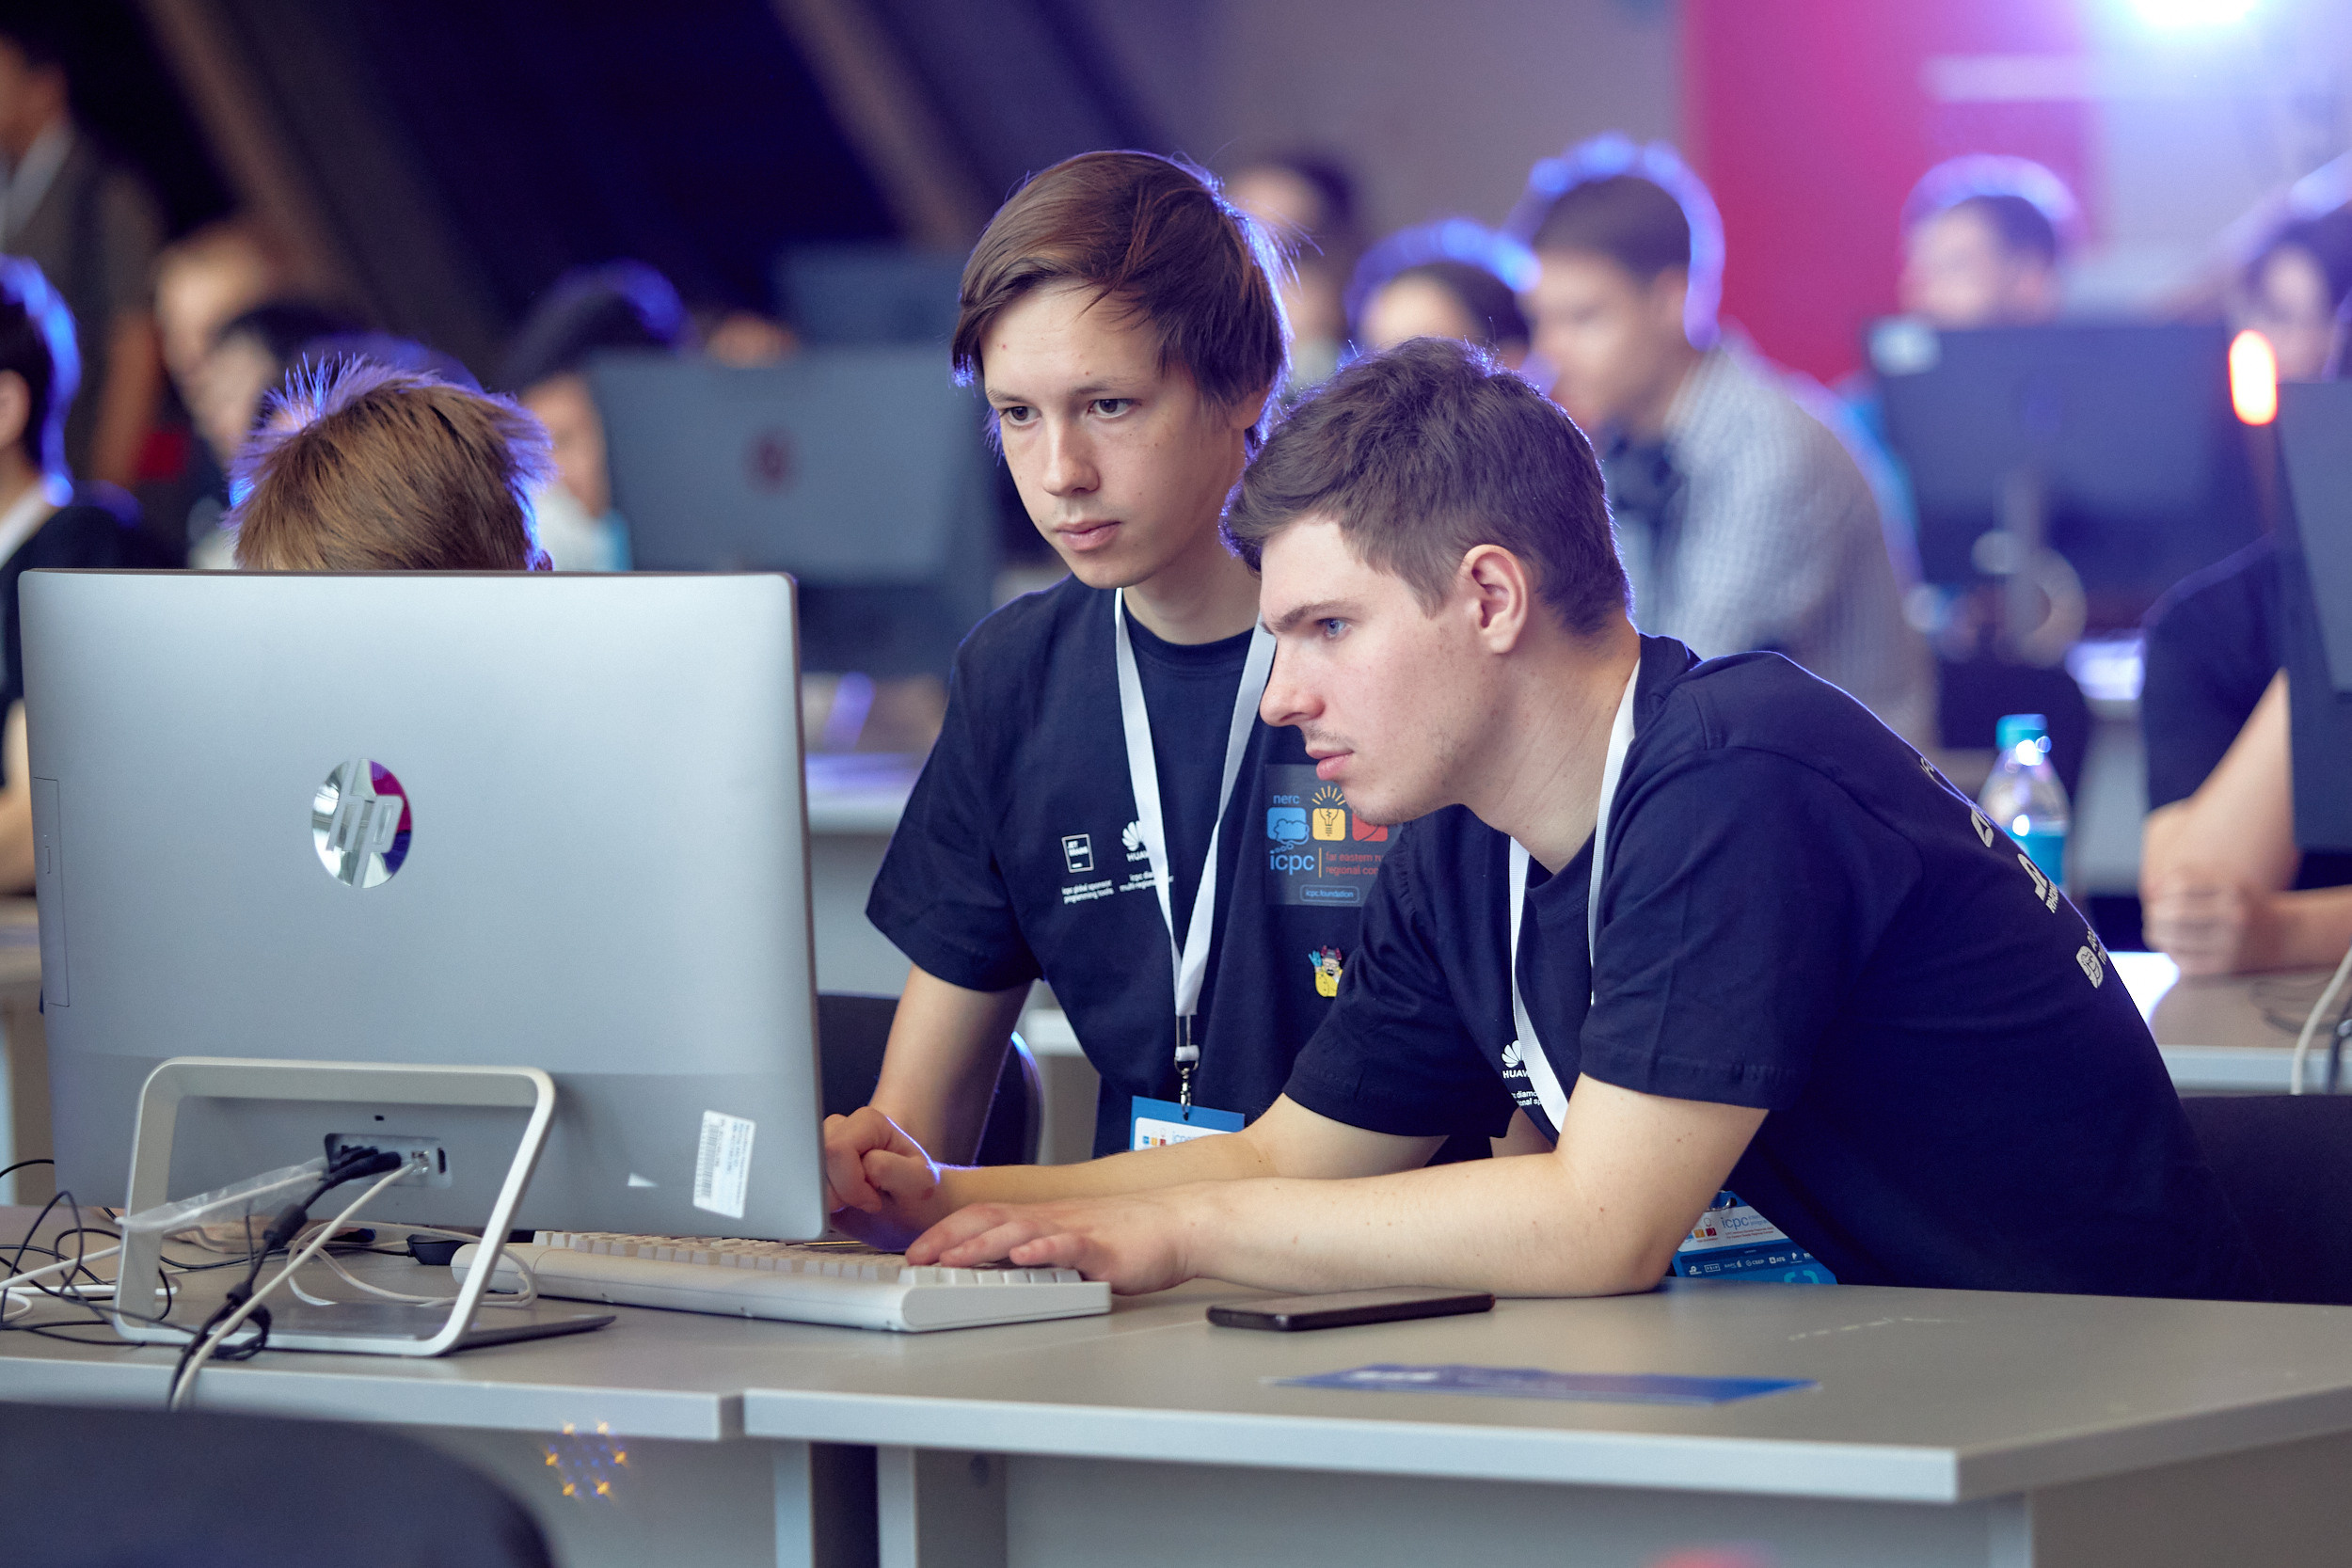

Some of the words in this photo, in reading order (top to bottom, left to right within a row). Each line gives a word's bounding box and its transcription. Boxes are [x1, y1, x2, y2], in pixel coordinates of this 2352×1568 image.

[1273, 794, 1300, 804] nerc
[326, 758, 405, 888] hp
[1269, 849, 1315, 876] icpc
[1326, 864, 1361, 877] regional
[1720, 1216, 1750, 1230] icpc
